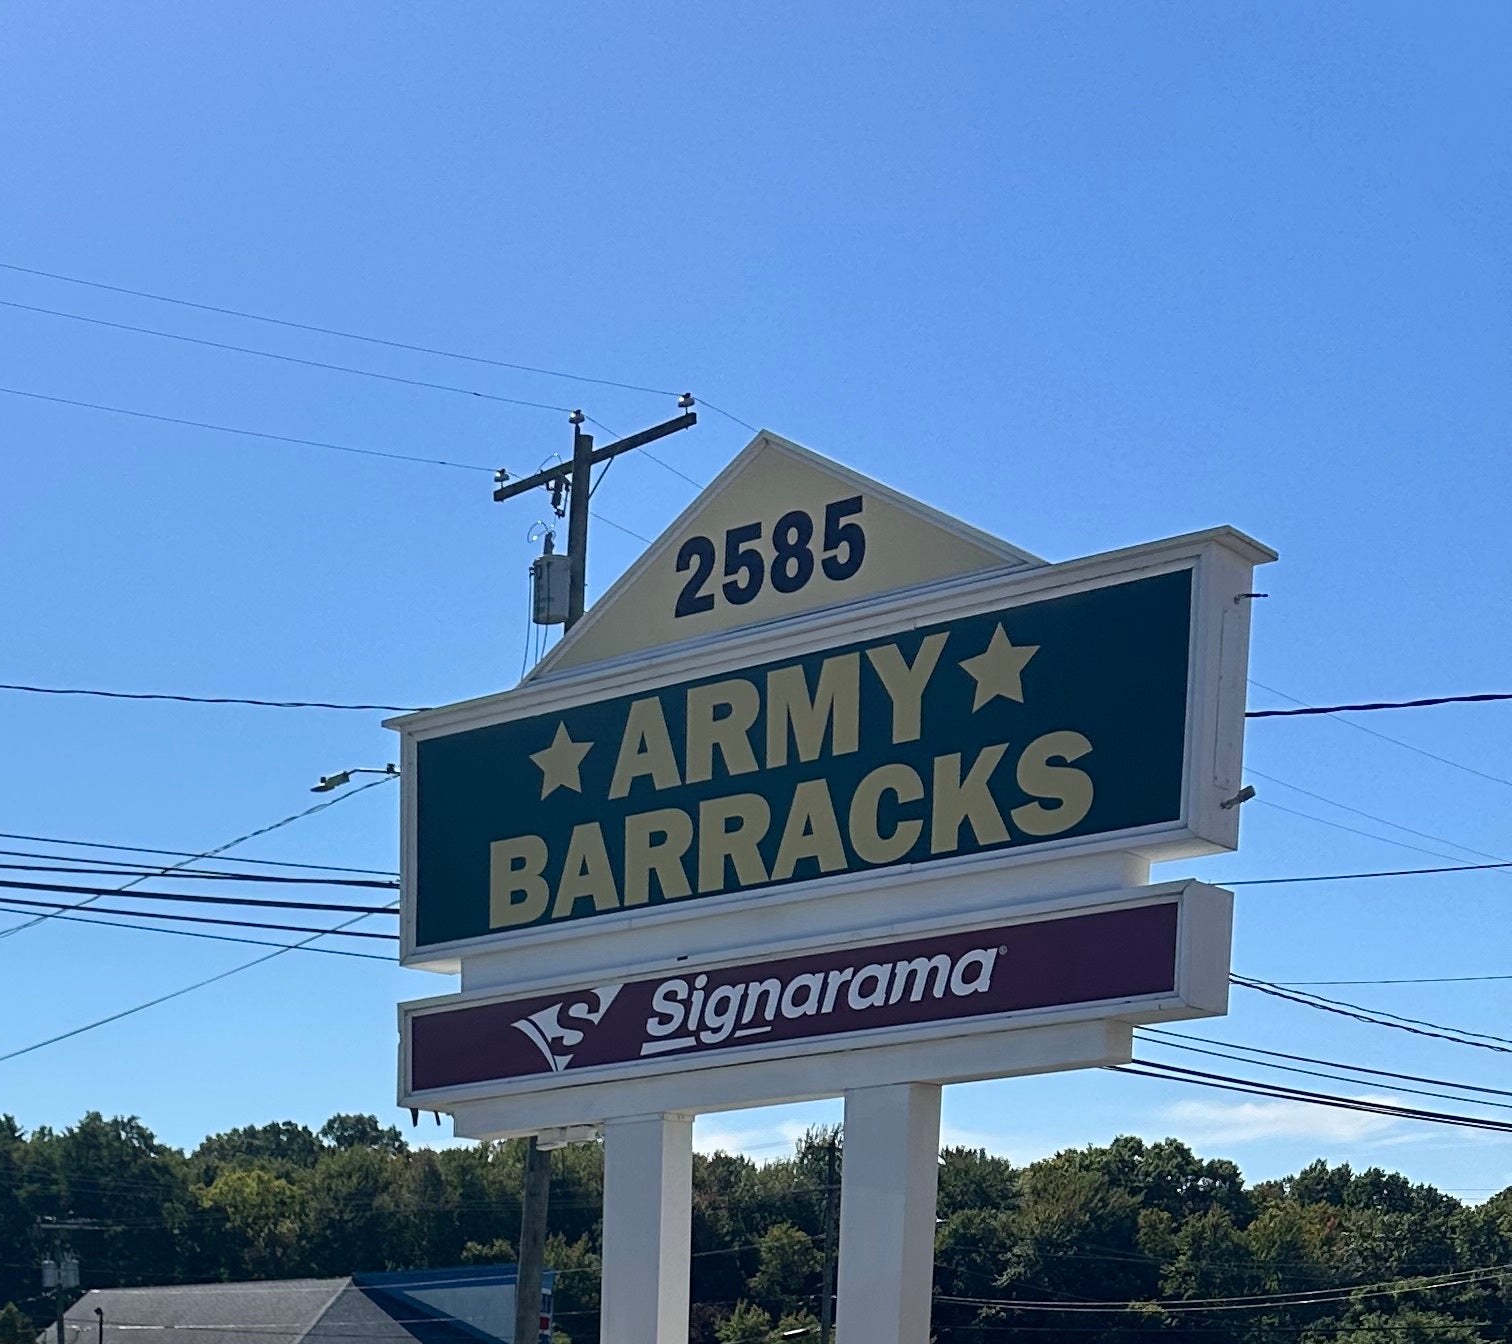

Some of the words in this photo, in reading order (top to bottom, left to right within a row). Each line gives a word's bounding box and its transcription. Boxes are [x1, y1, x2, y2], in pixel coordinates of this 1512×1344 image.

[674, 495, 867, 619] 2585
[608, 630, 951, 800] ARMY
[488, 730, 1095, 930] BARRACKS
[643, 947, 998, 1046] Signarama
